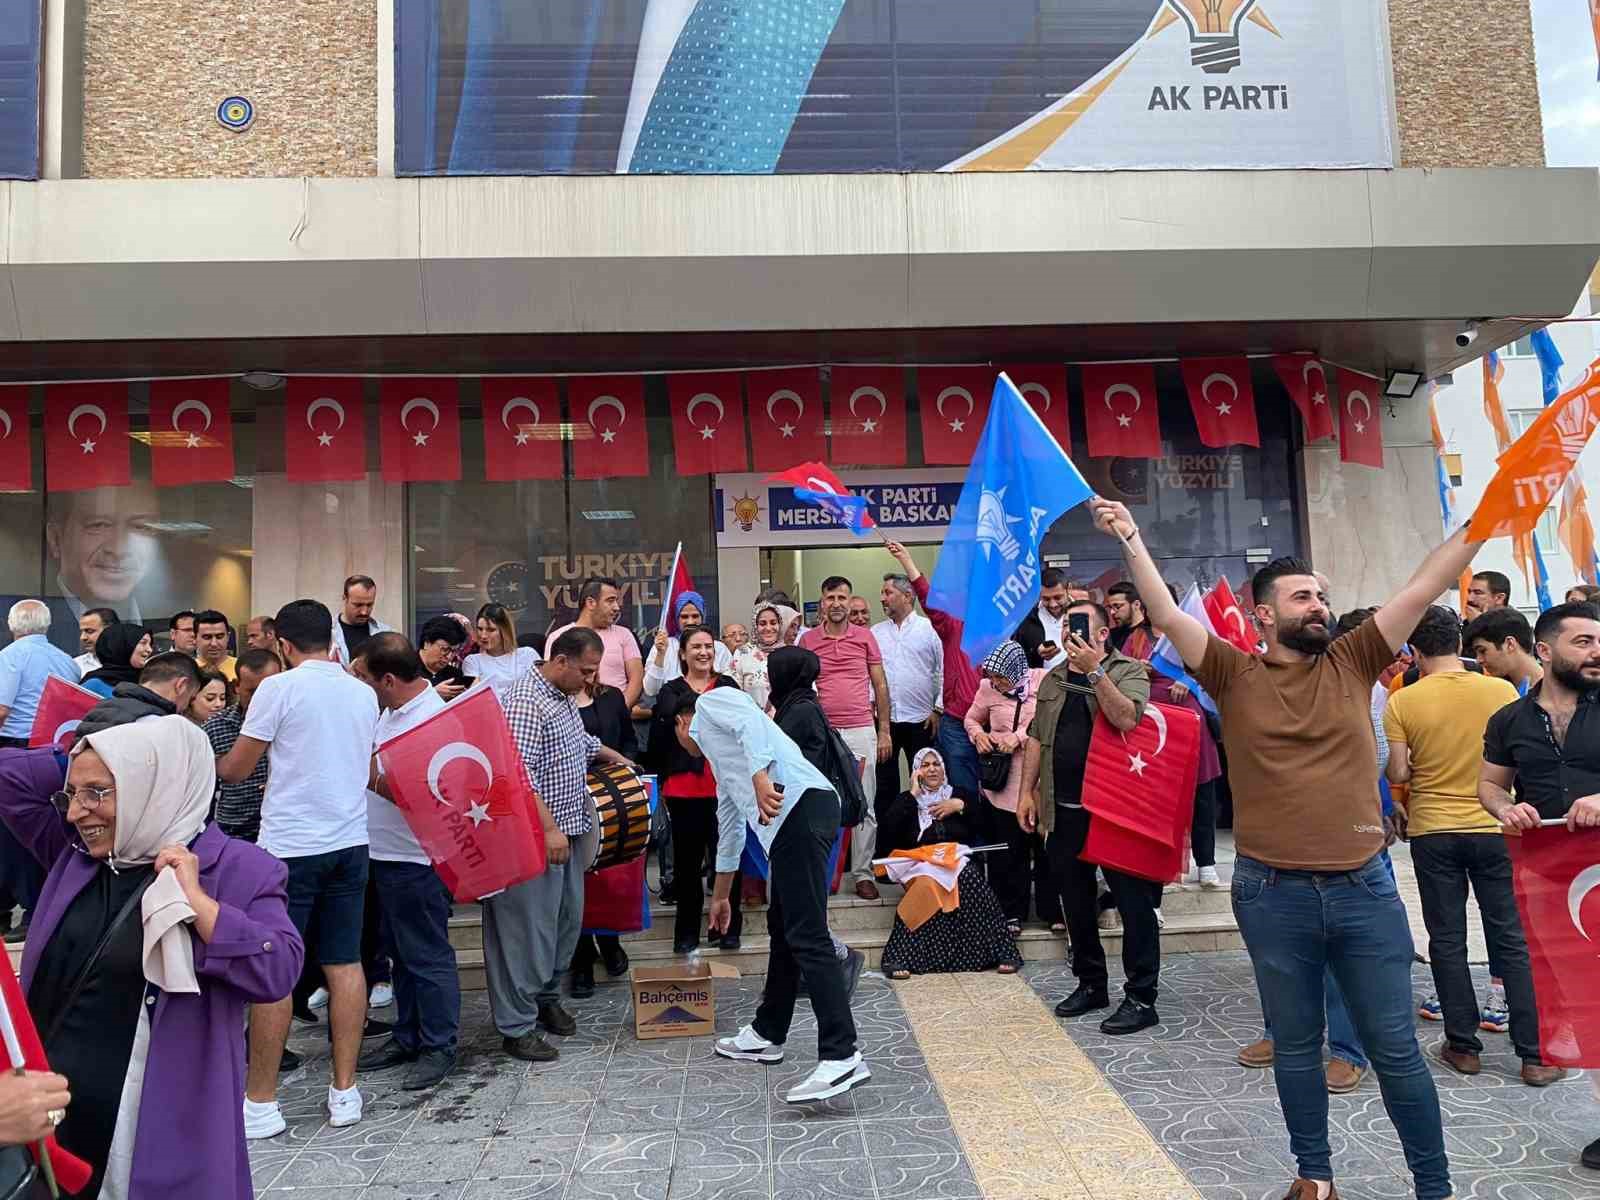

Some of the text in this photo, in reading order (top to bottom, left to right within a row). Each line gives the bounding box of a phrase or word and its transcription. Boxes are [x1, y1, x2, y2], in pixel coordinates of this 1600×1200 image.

[1148, 86, 1192, 111] AK
[879, 504, 956, 524] BAŞKA
[540, 581, 668, 609] YÜYILI
